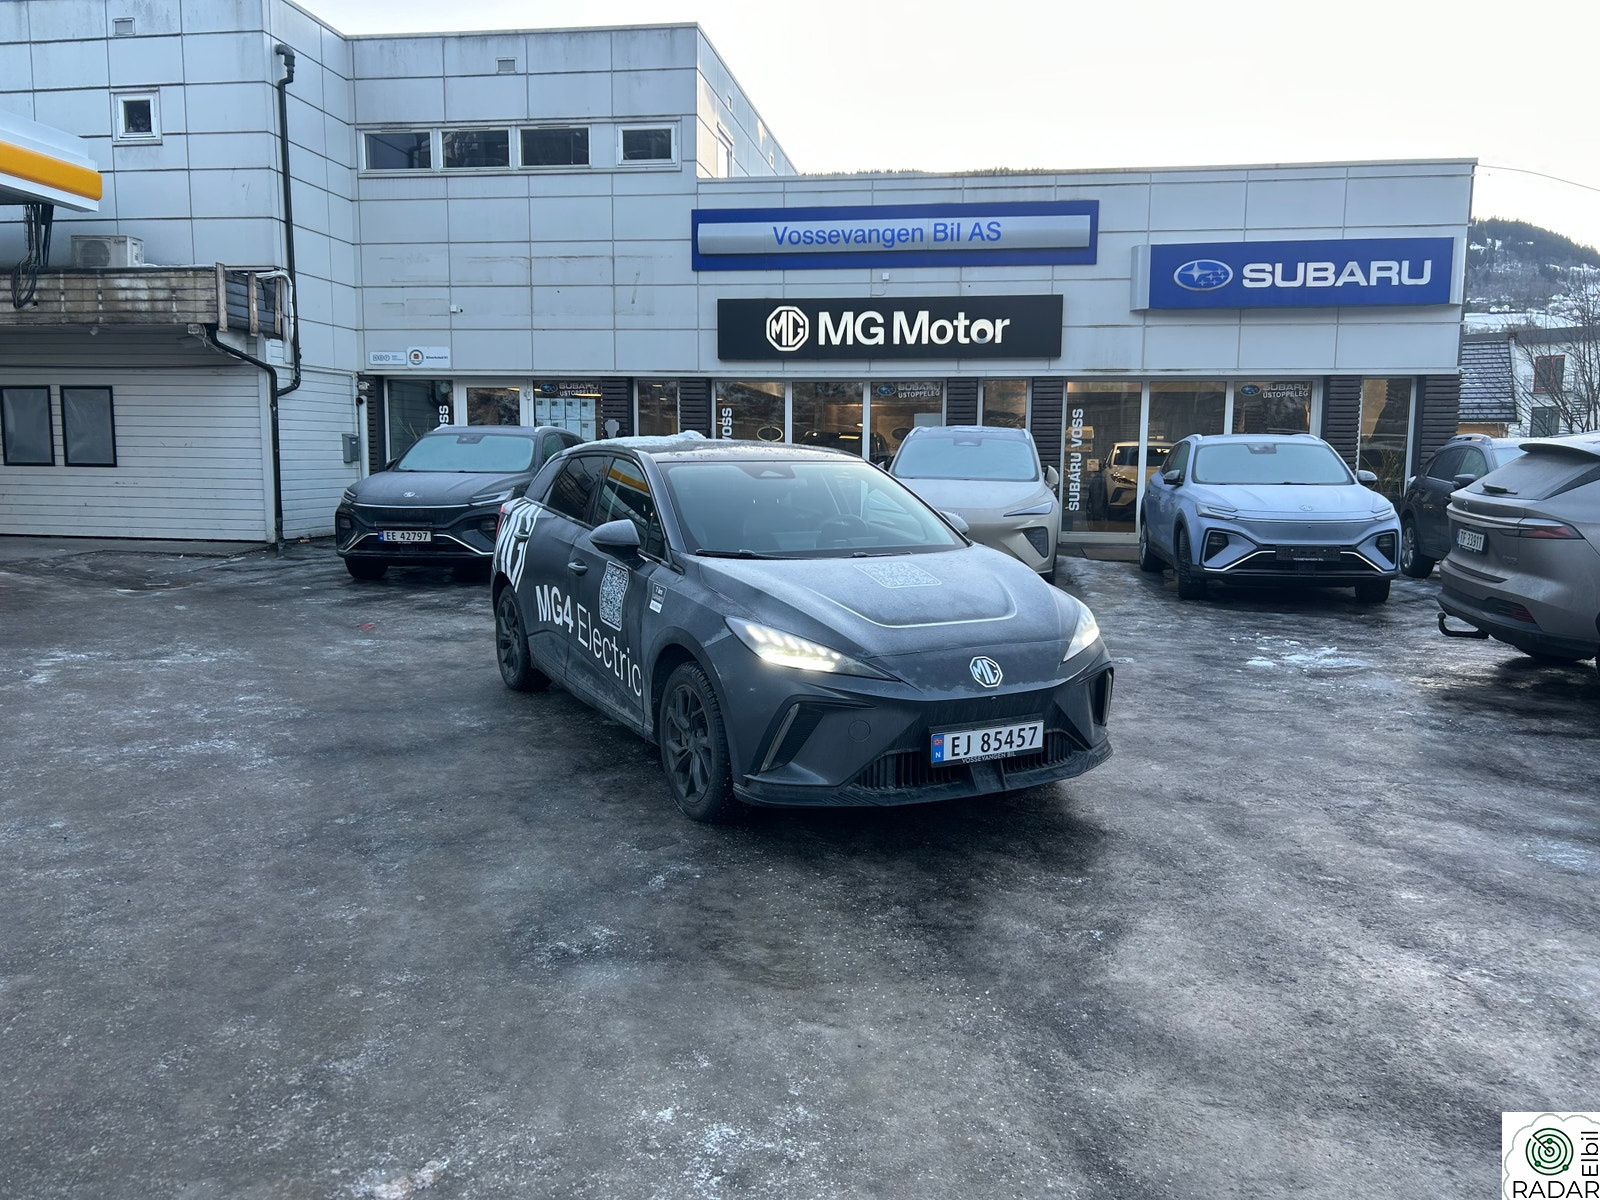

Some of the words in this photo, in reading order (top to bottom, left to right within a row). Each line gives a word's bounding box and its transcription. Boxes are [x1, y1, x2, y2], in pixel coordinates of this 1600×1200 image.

[773, 225, 924, 248] Vossevangen
[933, 221, 961, 243] Bil
[969, 221, 1002, 242] AS
[1242, 259, 1432, 288] SUBARU
[767, 307, 808, 350] MG
[818, 310, 885, 346] MG
[893, 309, 1011, 345] Motor
[559, 382, 600, 390] SUBARU
[898, 383, 941, 391] SUBARU
[1262, 383, 1310, 391] SUBARU
[1262, 390, 1309, 399] USTOPPELEG
[1071, 408, 1084, 448] VOSS
[1068, 452, 1082, 511] SUBARU
[386, 531, 397, 541] EE
[400, 531, 428, 541] 42797
[535, 584, 574, 633] MG4
[577, 602, 642, 697] Electric
[970, 657, 1002, 687] MG
[951, 734, 971, 757] EJ
[981, 726, 1038, 753] 85457
[961, 752, 1007, 764] VOSSEVANGEN
